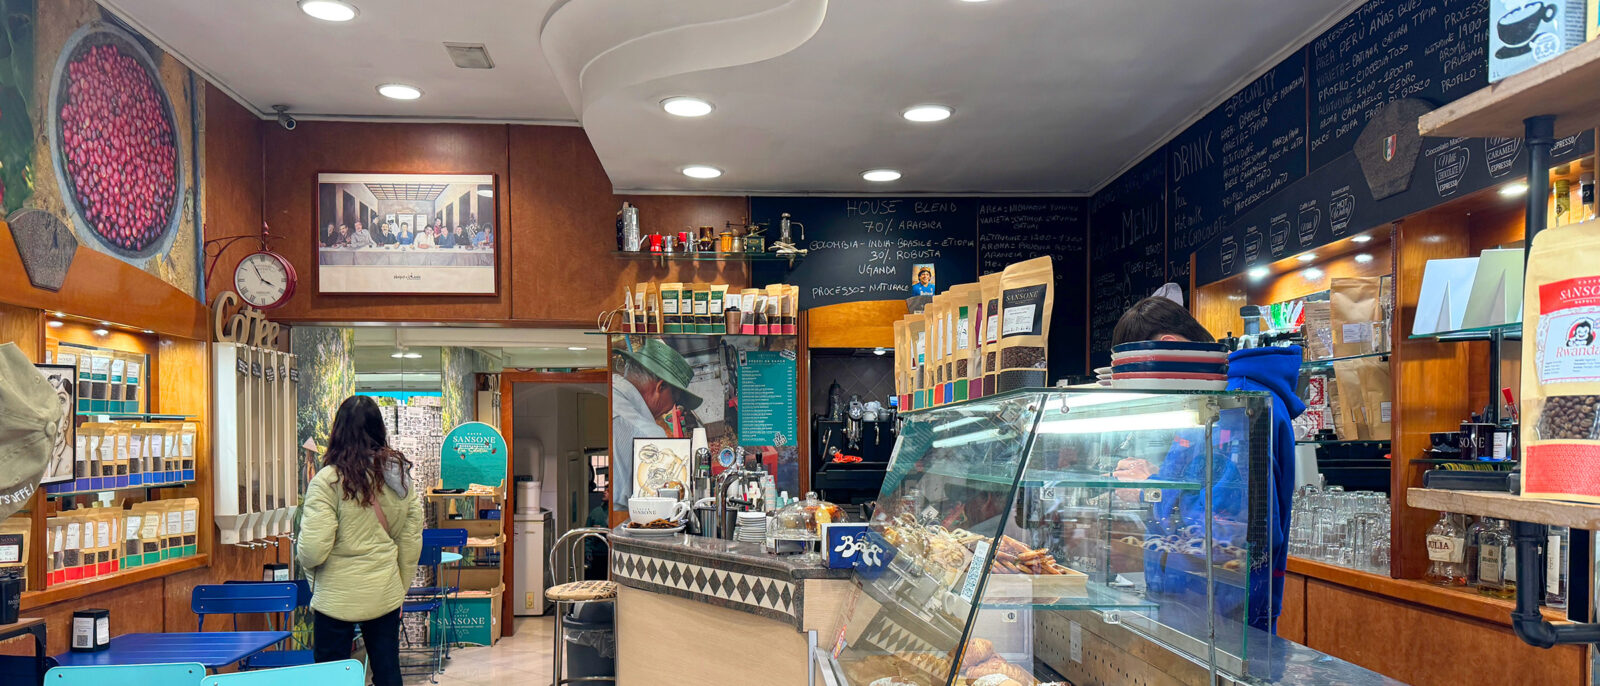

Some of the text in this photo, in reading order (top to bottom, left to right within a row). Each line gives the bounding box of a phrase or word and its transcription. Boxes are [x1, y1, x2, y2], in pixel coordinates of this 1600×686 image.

[1174, 130, 1214, 183] DRINK
[1487, 144, 1516, 160] CARAMEL
[1490, 159, 1512, 173] ESPRESSO
[846, 200, 957, 218] HOUSE BLEND
[862, 218, 942, 236] 70% ARABICA
[1122, 200, 1159, 248] MENU
[896, 250, 941, 261] ROBUSTA
[858, 264, 896, 276] UGANDA
[1005, 290, 1039, 302] SANSONE
[452, 436, 496, 444] SANSONE
